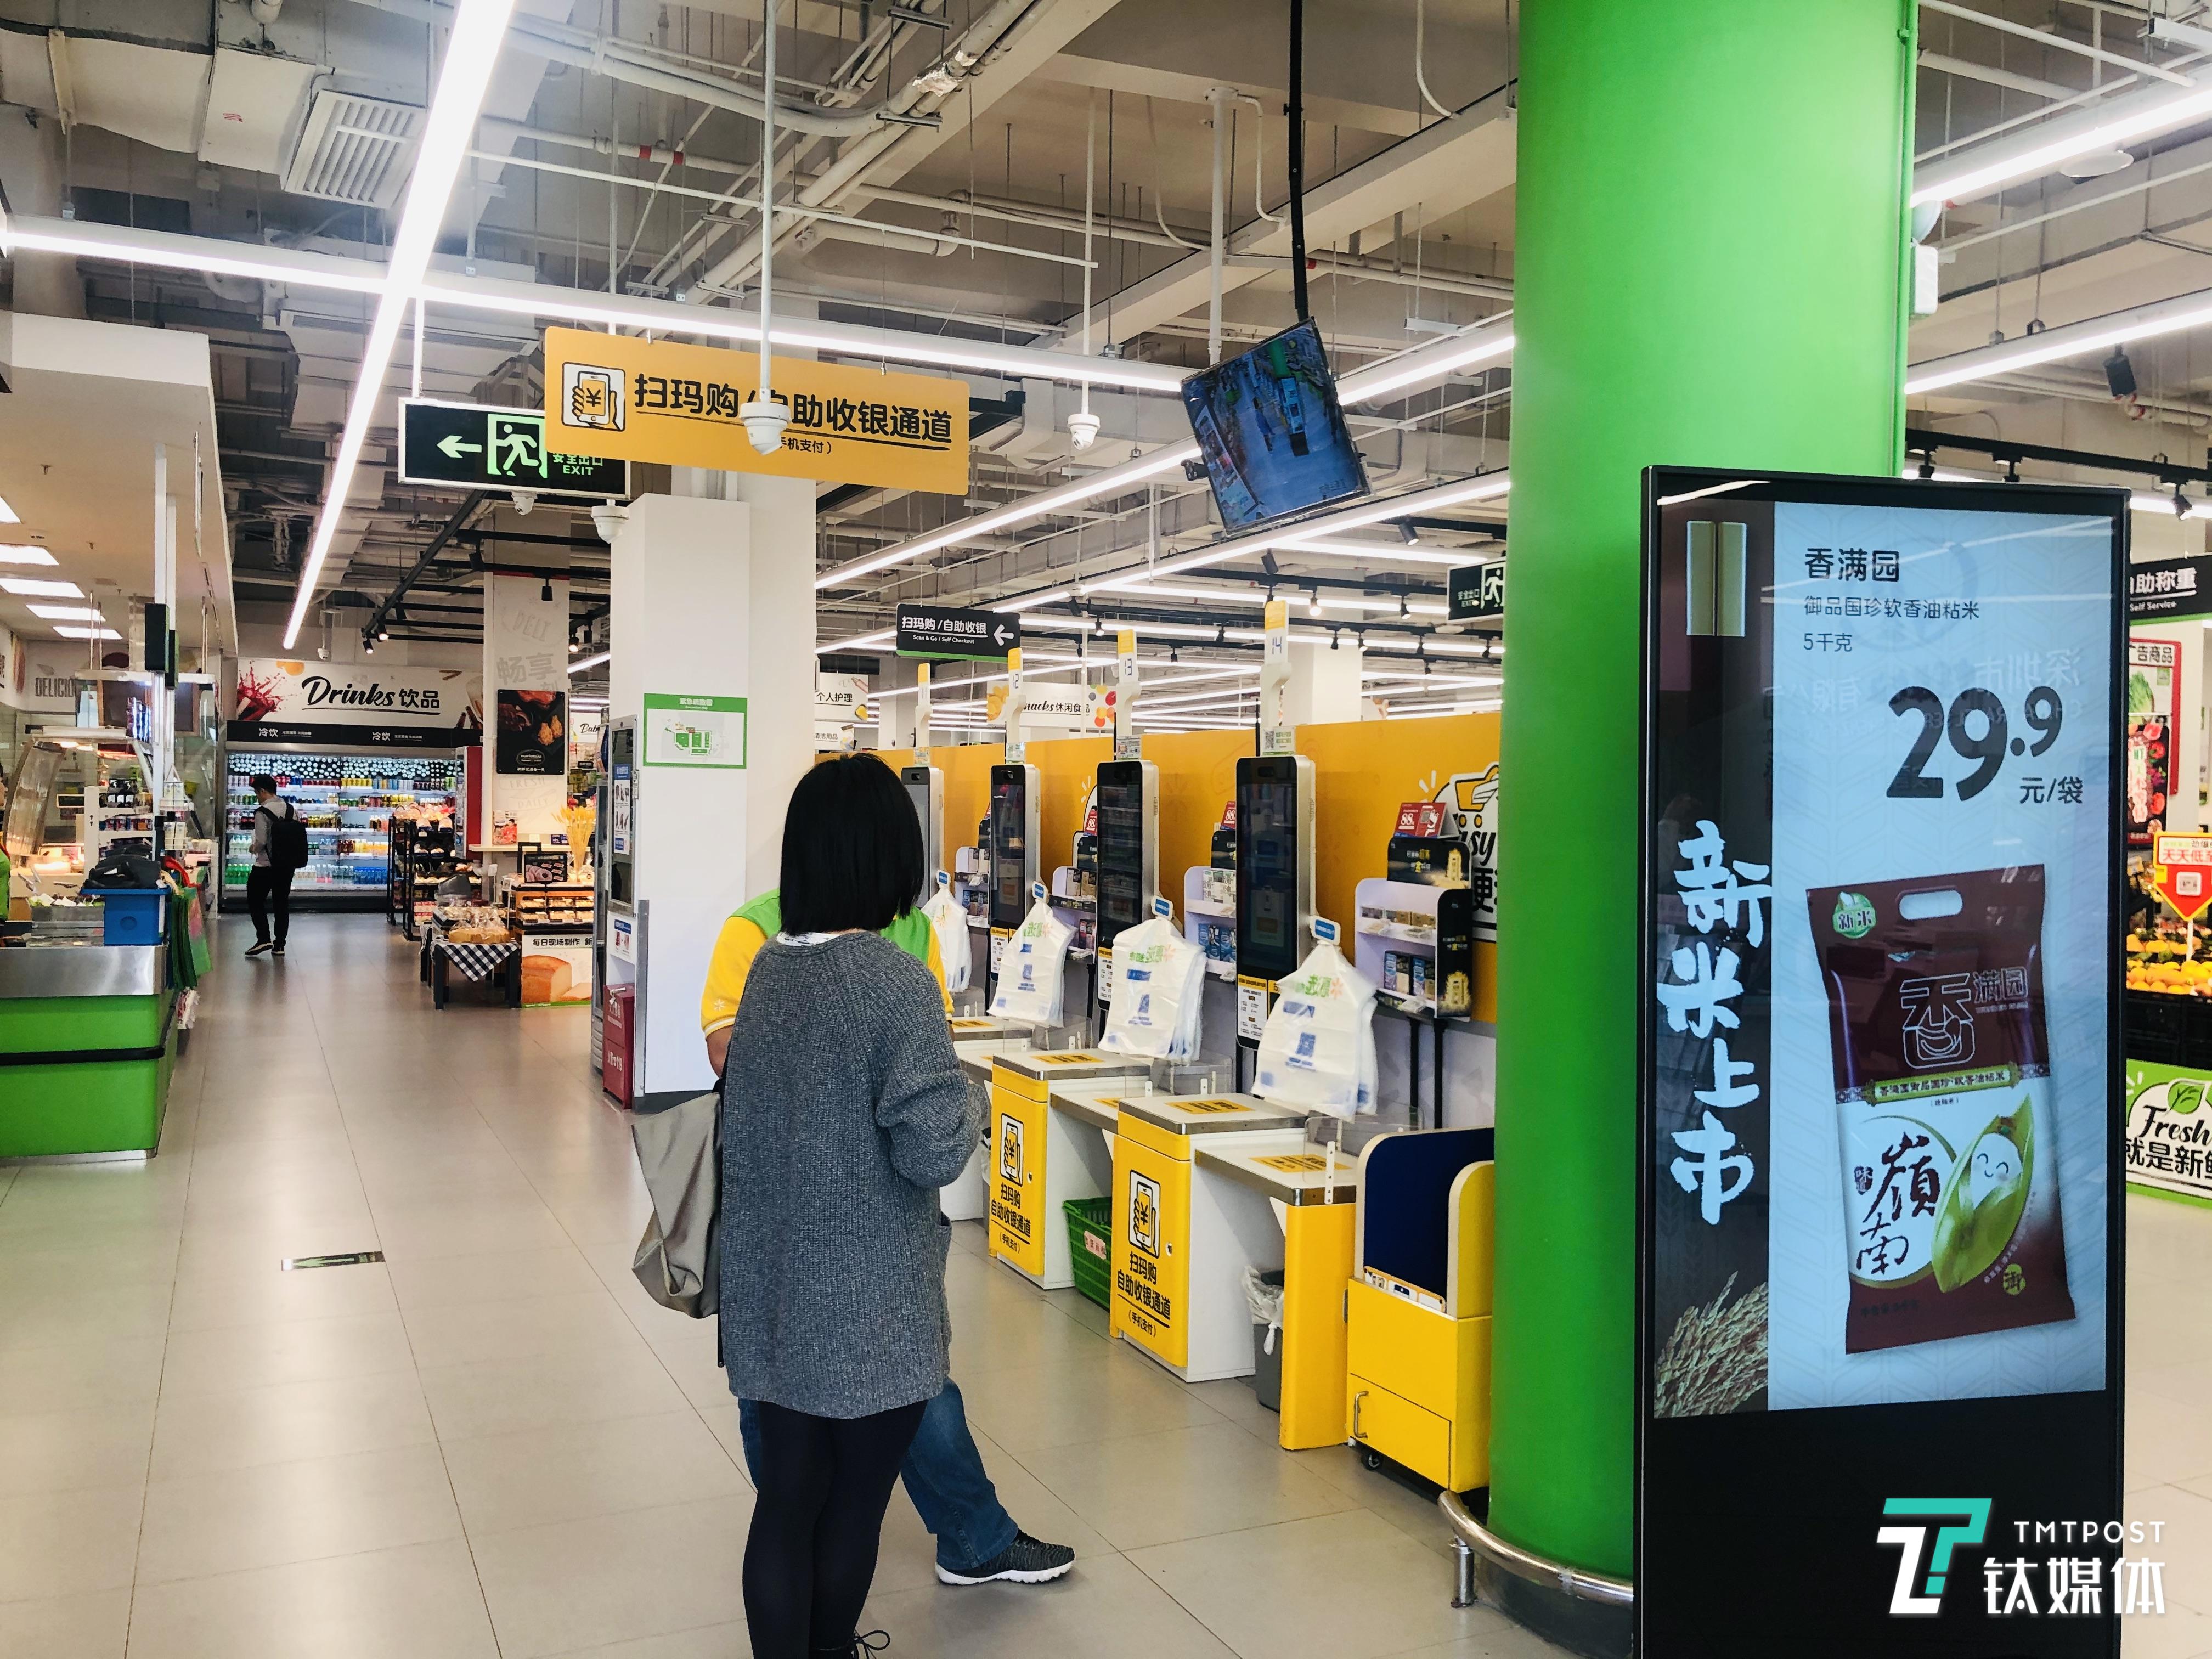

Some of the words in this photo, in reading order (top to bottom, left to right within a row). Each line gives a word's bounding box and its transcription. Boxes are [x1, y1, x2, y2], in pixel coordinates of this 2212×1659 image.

[779, 436, 832, 454] 手机支付）
[563, 465, 594, 476] EXIT
[1805, 548, 1899, 582] 香满园
[1462, 599, 1480, 607] EX
[1804, 596, 1980, 620] 御品国珍软香油粘米
[2130, 602, 2145, 612] Self
[2146, 600, 2177, 610] Service
[901, 616, 988, 634] 扫玛购/自助收银
[1803, 633, 1853, 652] 5千克
[496, 652, 557, 685] 畅享
[301, 676, 395, 707] Drinks
[398, 688, 440, 709] 饮品
[816, 692, 853, 703] 个人护理
[1023, 701, 1054, 712] nacks
[259, 728, 278, 737] 冷饮
[372, 732, 391, 741] 冷饮
[1886, 686, 2064, 802] 29.9
[2019, 777, 2083, 805] 元/袋
[1838, 910, 1872, 930] 新米
[1656, 820, 1772, 1224] 新米上市
[2139, 1104, 2212, 1146] Fresh
[1001, 1181, 1021, 1209] 扫玛购
[991, 1198, 1031, 1238] 自助收银通道
[1130, 1251, 1157, 1285] 扫玛购
[1118, 1269, 1171, 1320] 自助收银通道
